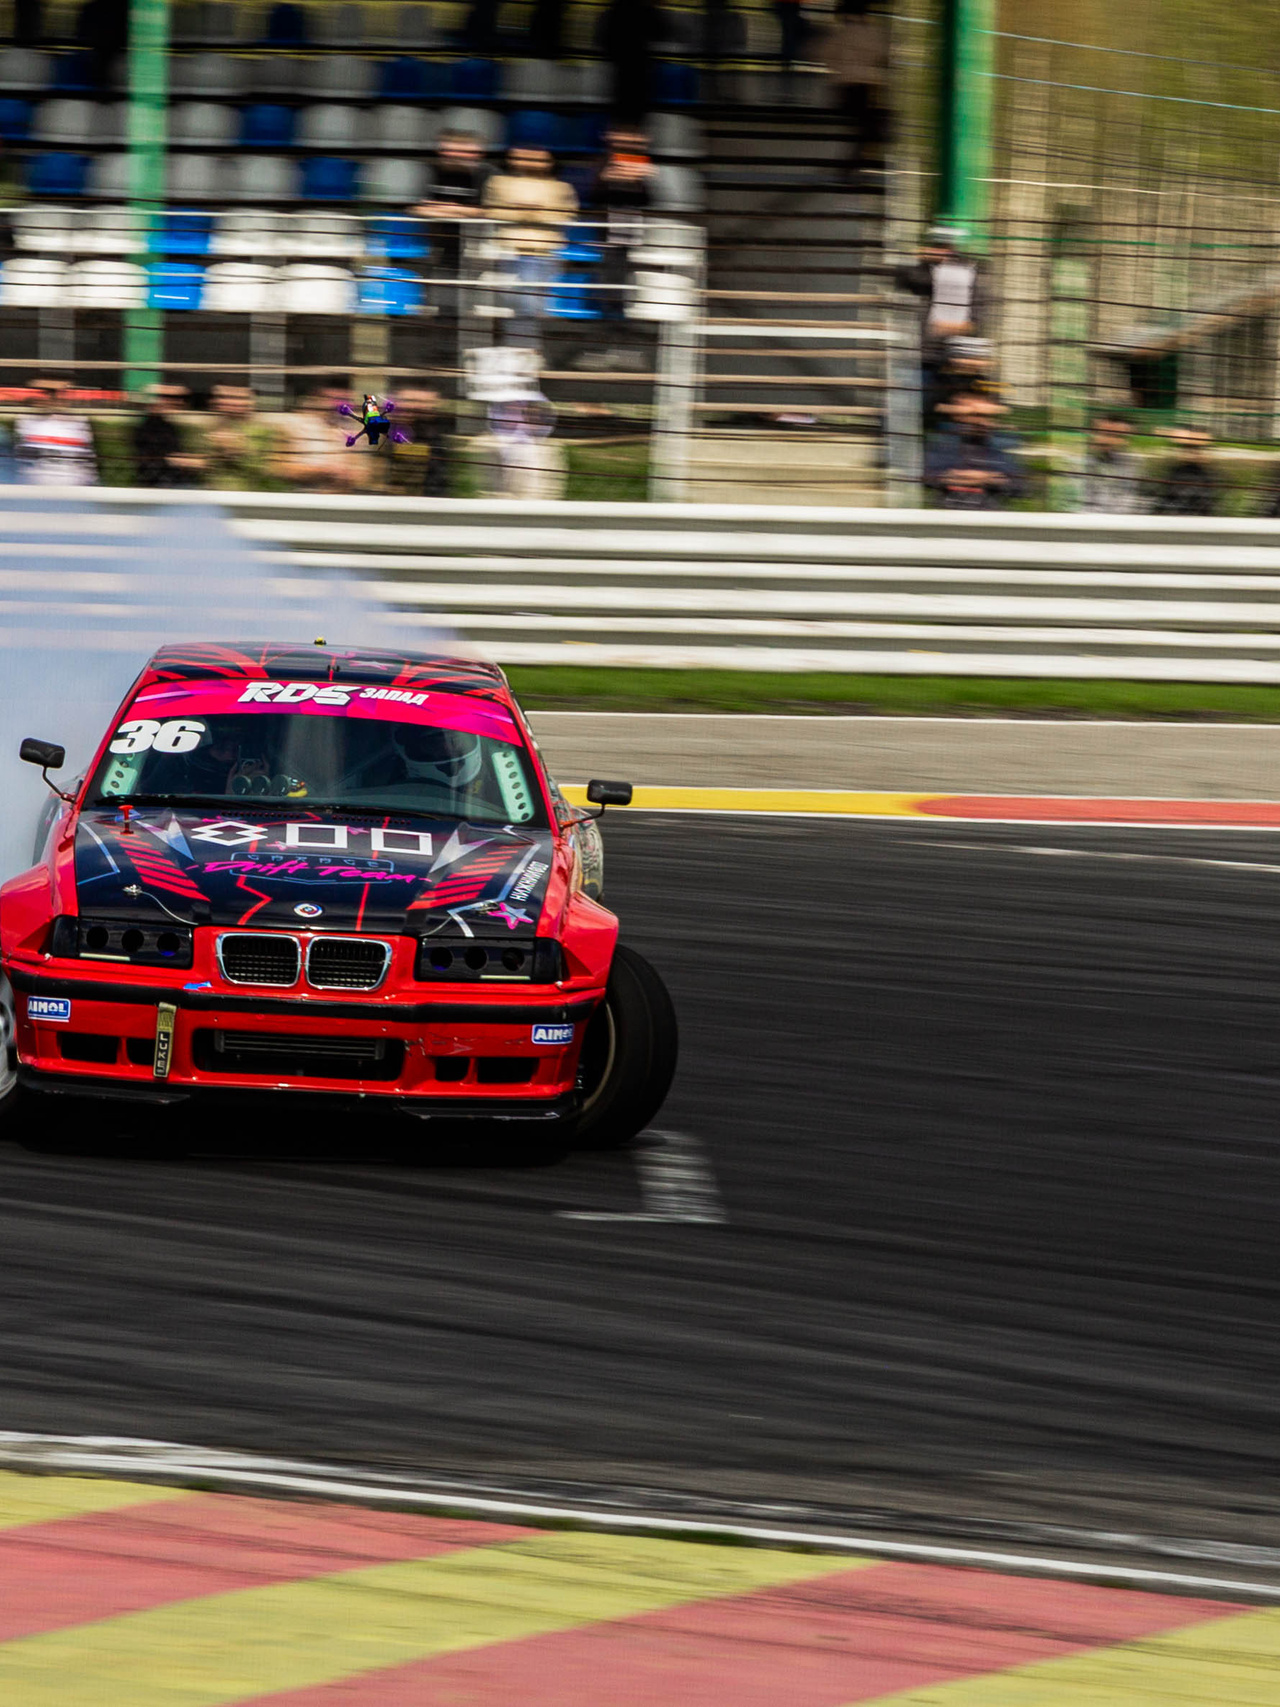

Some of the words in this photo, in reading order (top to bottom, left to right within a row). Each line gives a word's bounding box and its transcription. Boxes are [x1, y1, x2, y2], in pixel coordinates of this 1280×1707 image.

[237, 681, 360, 706] RDS
[359, 687, 430, 706] ЗАПАД
[109, 719, 206, 754] 36
[28, 1000, 67, 1013] AIMOL
